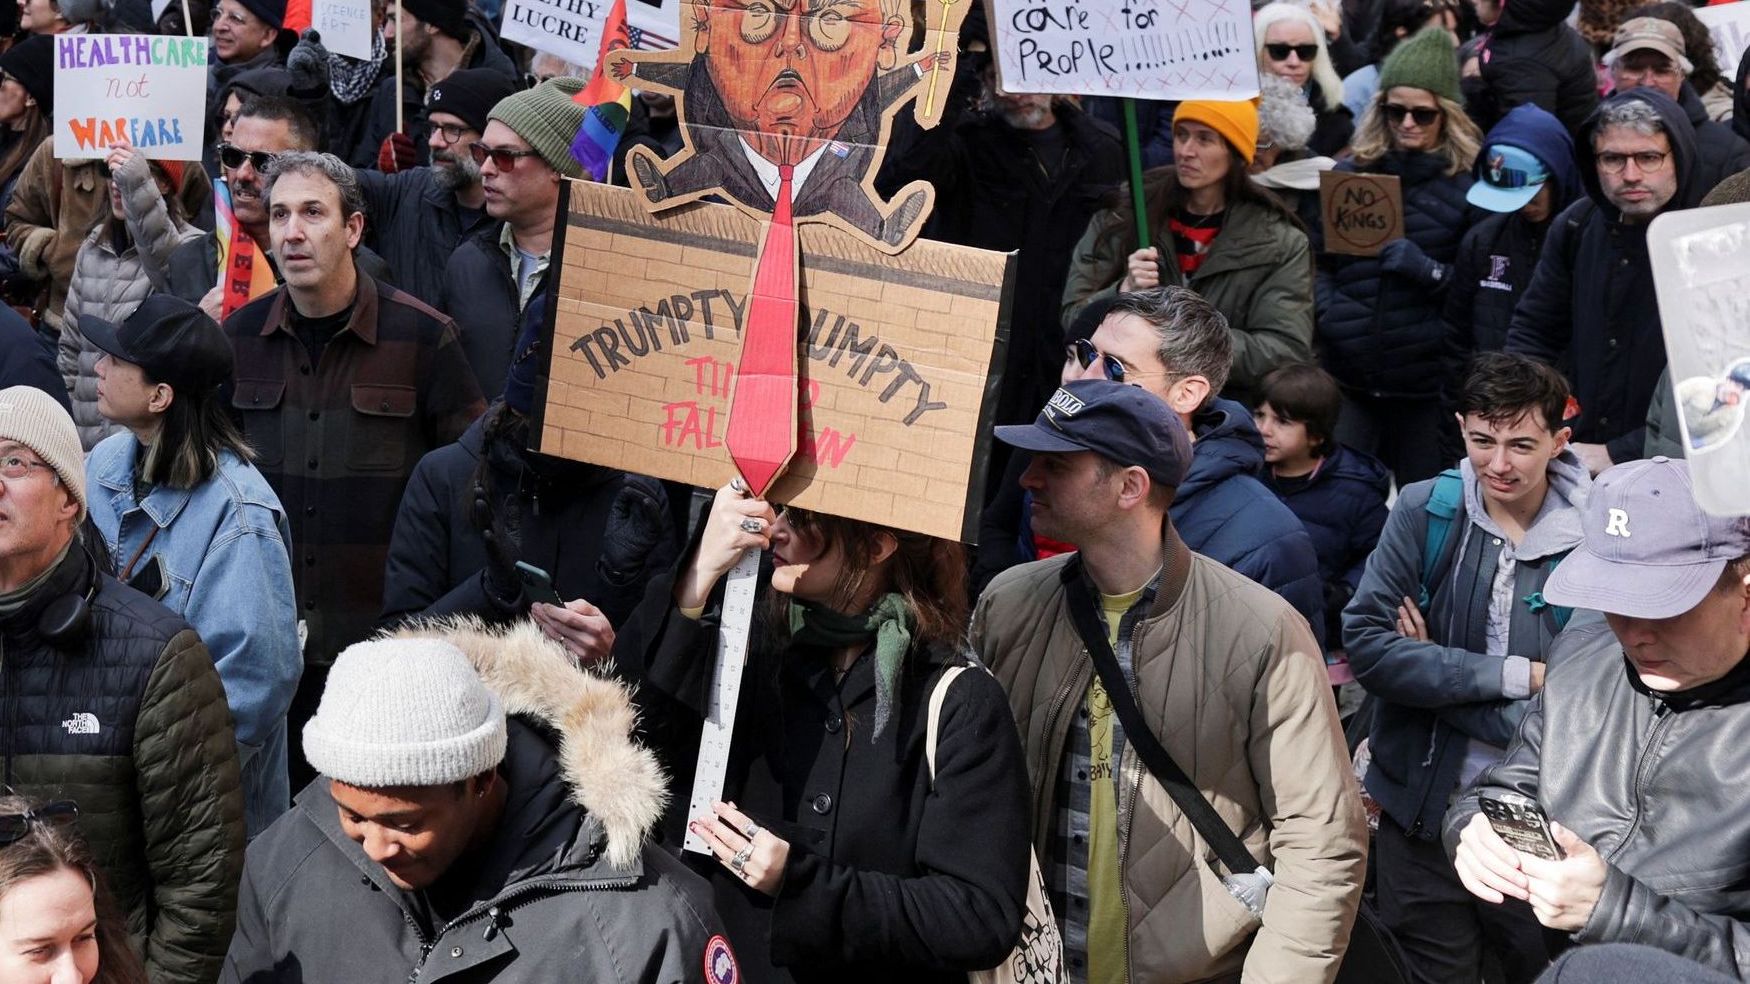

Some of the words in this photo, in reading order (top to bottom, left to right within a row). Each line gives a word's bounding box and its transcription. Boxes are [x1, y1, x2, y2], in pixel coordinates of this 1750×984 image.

[511, 4, 589, 45] LUCRE
[59, 35, 207, 69] HEALTHCARE
[106, 73, 150, 100] not
[67, 115, 184, 150] WARFARE
[1344, 186, 1375, 206] NO
[1334, 208, 1388, 233] KINGS
[569, 288, 749, 380] TRUMPTY
[806, 304, 948, 427] UMPTY
[1050, 389, 1083, 414] BOLO
[1605, 507, 1632, 538] R
[61, 719, 89, 728] NORTH
[72, 712, 88, 721] THE
[68, 726, 88, 735] FACE
